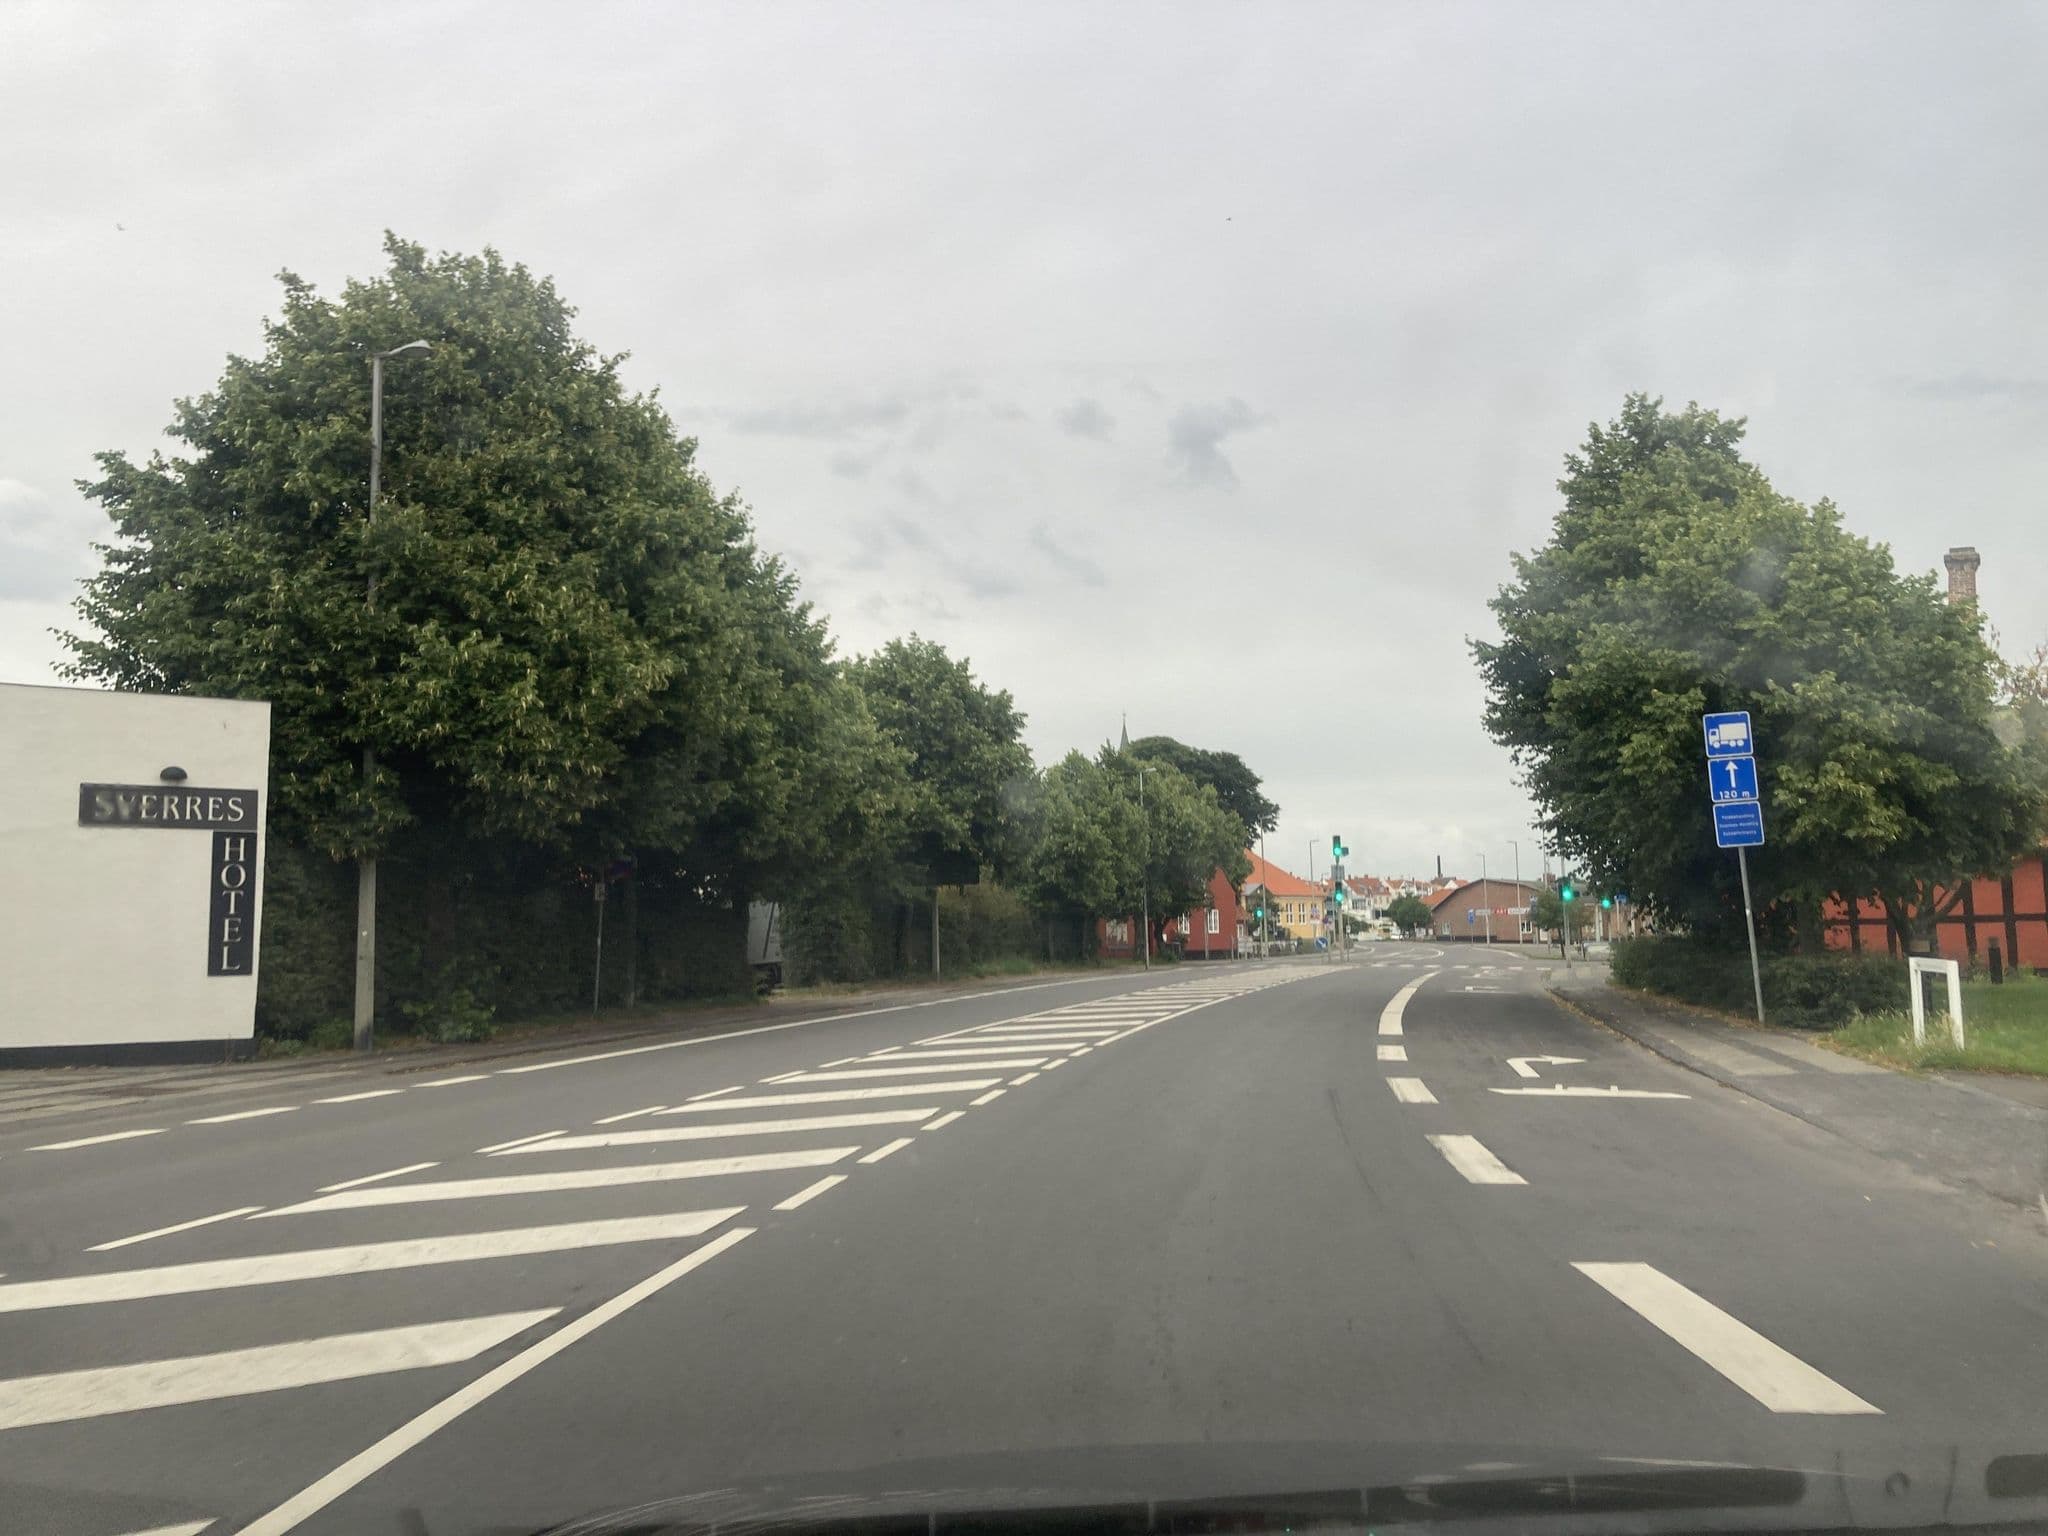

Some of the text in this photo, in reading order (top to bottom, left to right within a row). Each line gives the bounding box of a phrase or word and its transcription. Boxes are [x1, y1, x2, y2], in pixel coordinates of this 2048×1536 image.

[95, 791, 245, 822] SVERRES
[1719, 790, 1737, 799] 120
[220, 837, 247, 971] HOTEL
